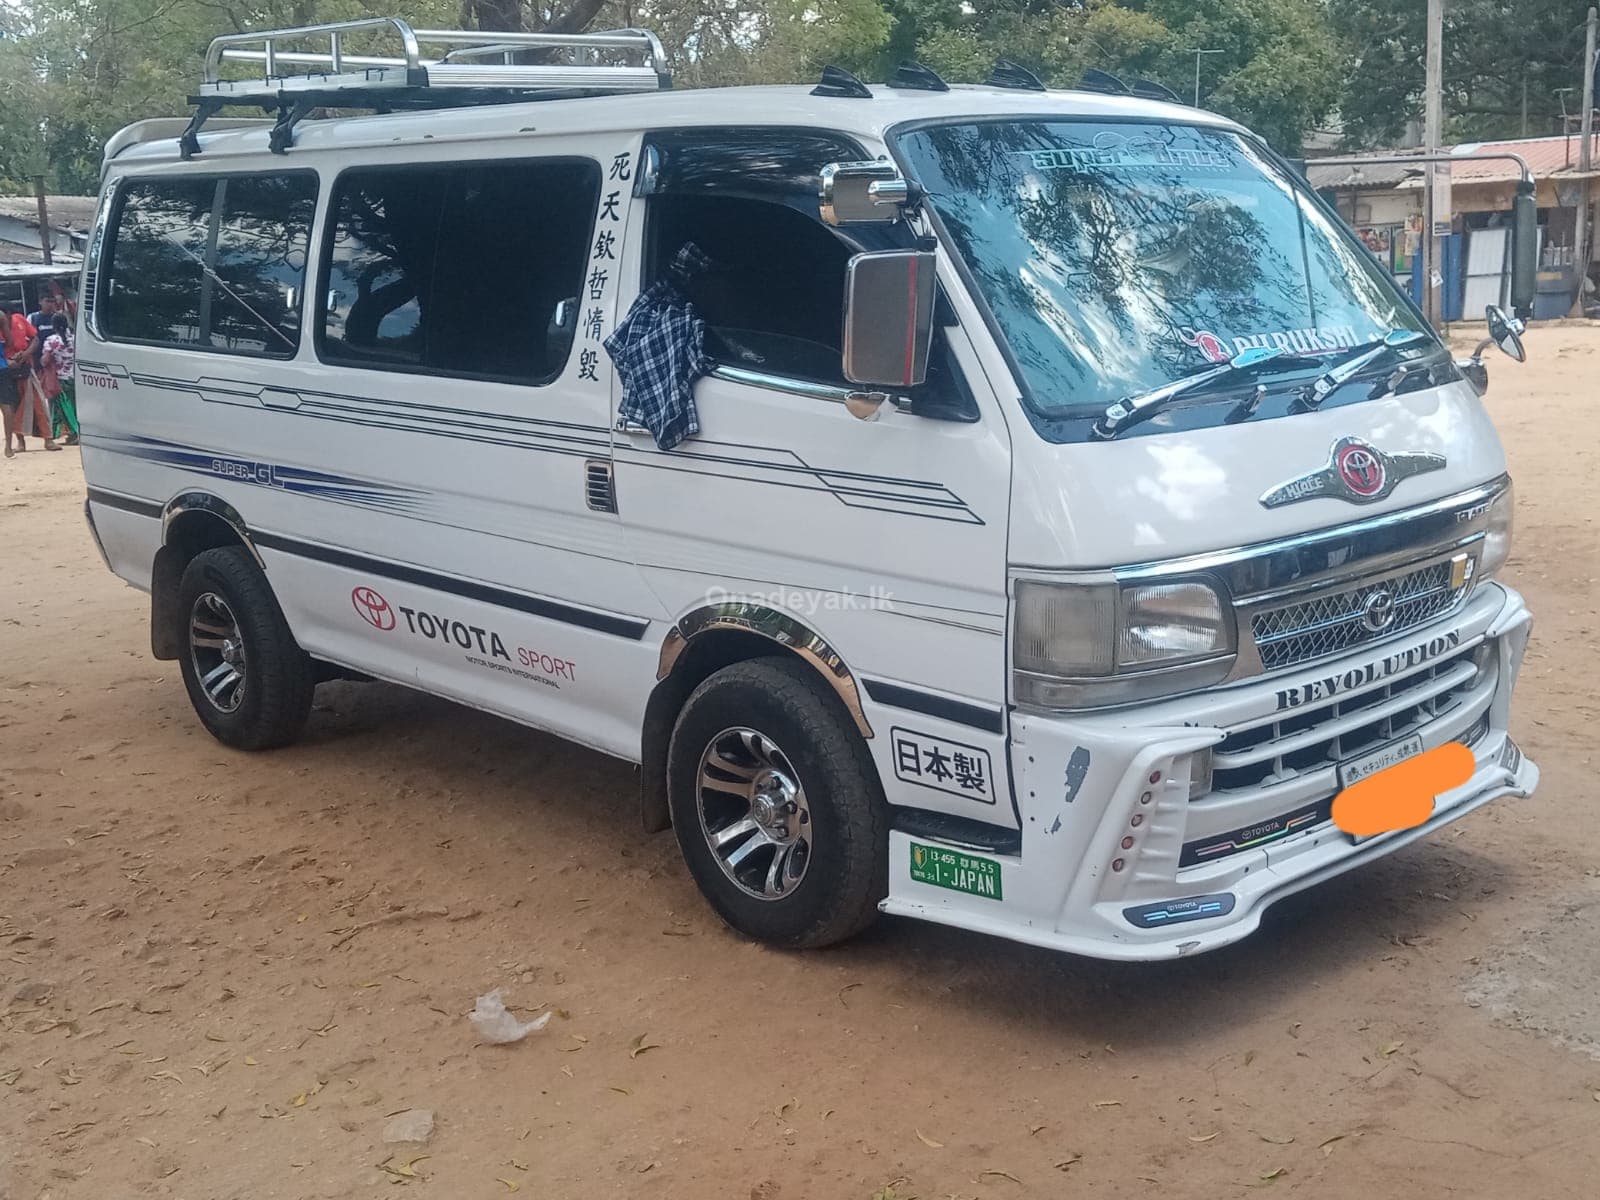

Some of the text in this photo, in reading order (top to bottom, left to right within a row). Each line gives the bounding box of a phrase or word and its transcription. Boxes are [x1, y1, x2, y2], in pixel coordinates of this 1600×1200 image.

[81, 374, 119, 390] TOYOTA
[398, 605, 576, 682] TOYOTA SPORT
[1275, 629, 1460, 711] REVOLUTION
[897, 738, 987, 795] 日本製
[1250, 821, 1280, 837] TOYOTA
